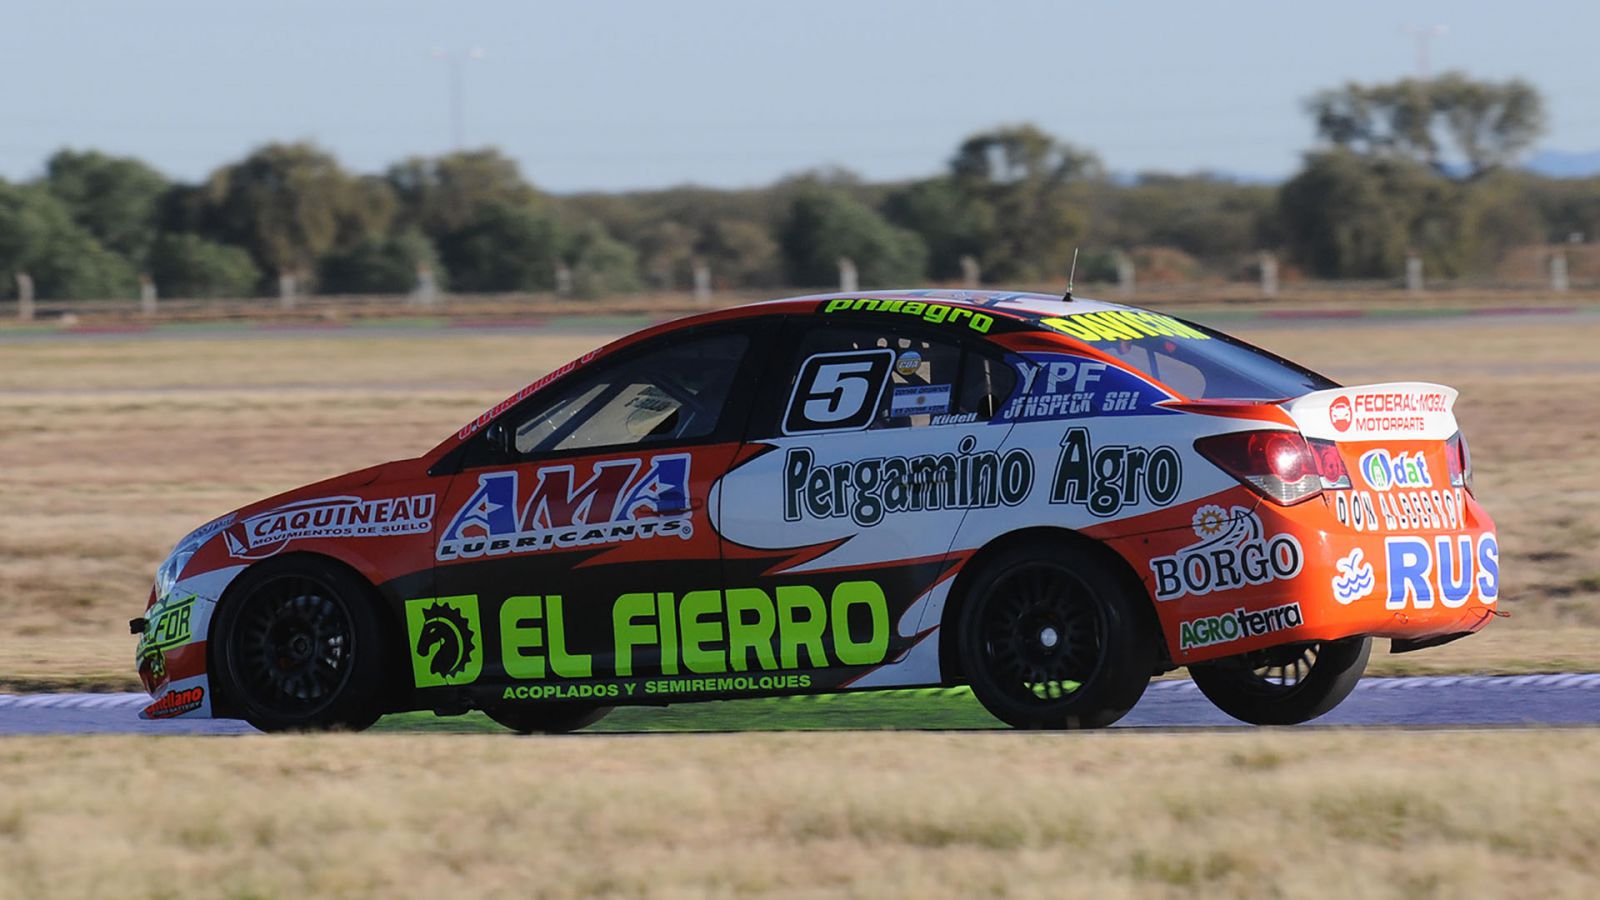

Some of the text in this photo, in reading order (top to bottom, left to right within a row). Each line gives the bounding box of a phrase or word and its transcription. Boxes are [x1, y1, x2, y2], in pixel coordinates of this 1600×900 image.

[804, 362, 873, 422] 5
[1016, 362, 1107, 394] YPF
[1103, 391, 1140, 411] SRL
[1356, 417, 1424, 431] MOTORPARTS
[441, 454, 691, 541] AMA
[785, 427, 1182, 526] Pergamino Agro
[252, 521, 429, 546] MOVIMIENTOS DE SUELO
[253, 497, 432, 537] CAQUINEAU
[440, 519, 681, 556] LUBRICANTS
[1152, 538, 1299, 597] BORGO
[1387, 536, 1499, 604] RUS
[500, 580, 889, 679] EL FIERRO
[1181, 604, 1302, 648] AGROterra
[503, 675, 812, 699] ACOPLADOS Y SEMIREMOLQUES
